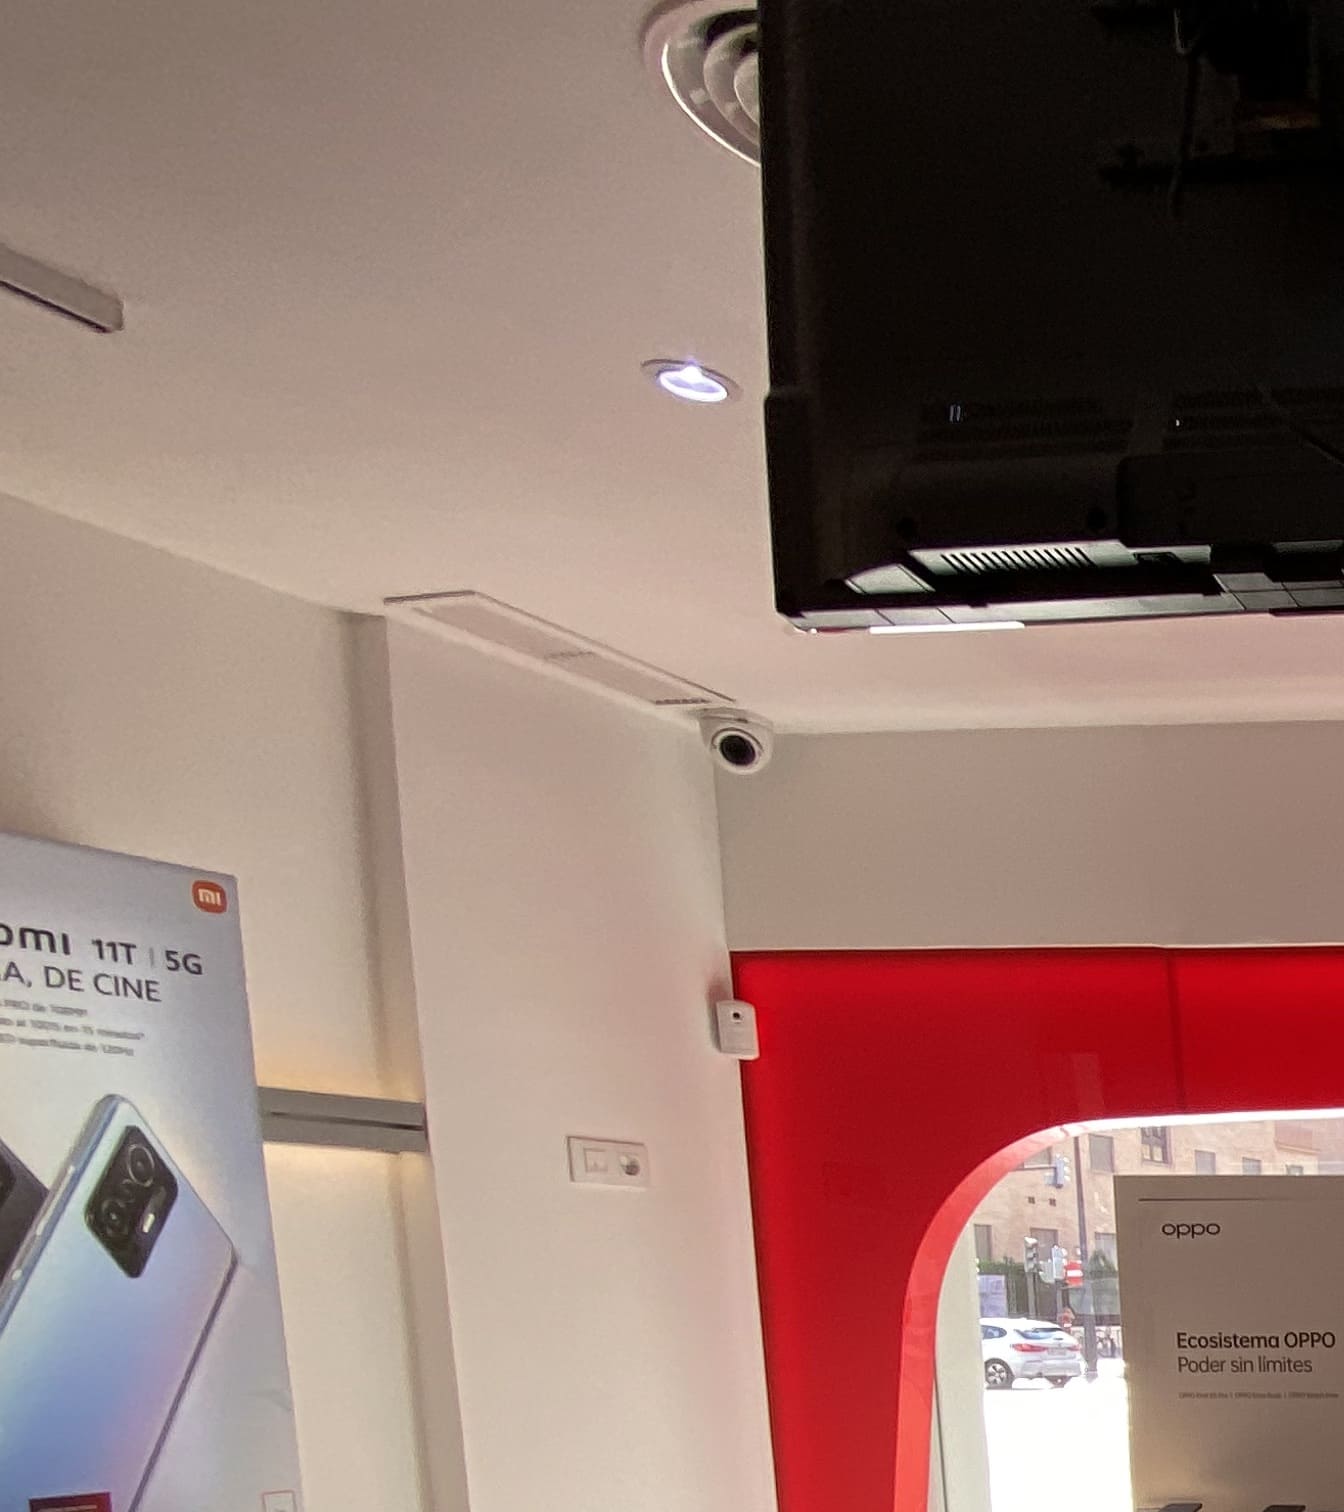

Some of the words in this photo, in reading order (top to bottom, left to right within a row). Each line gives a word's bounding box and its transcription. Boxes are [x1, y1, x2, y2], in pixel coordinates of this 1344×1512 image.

[91, 938, 137, 965] 11T
[165, 950, 203, 976] 5G
[0, 961, 32, 988] A,
[43, 965, 84, 992] DE
[93, 973, 162, 1002] CINE
[1162, 1223, 1221, 1239] oppo
[1177, 1332, 1280, 1349] Ecosistema
[1284, 1331, 1336, 1349] OPPO
[1178, 1356, 1226, 1373] Poder
[1230, 1356, 1254, 1373] sin
[1258, 1355, 1313, 1373] límites
